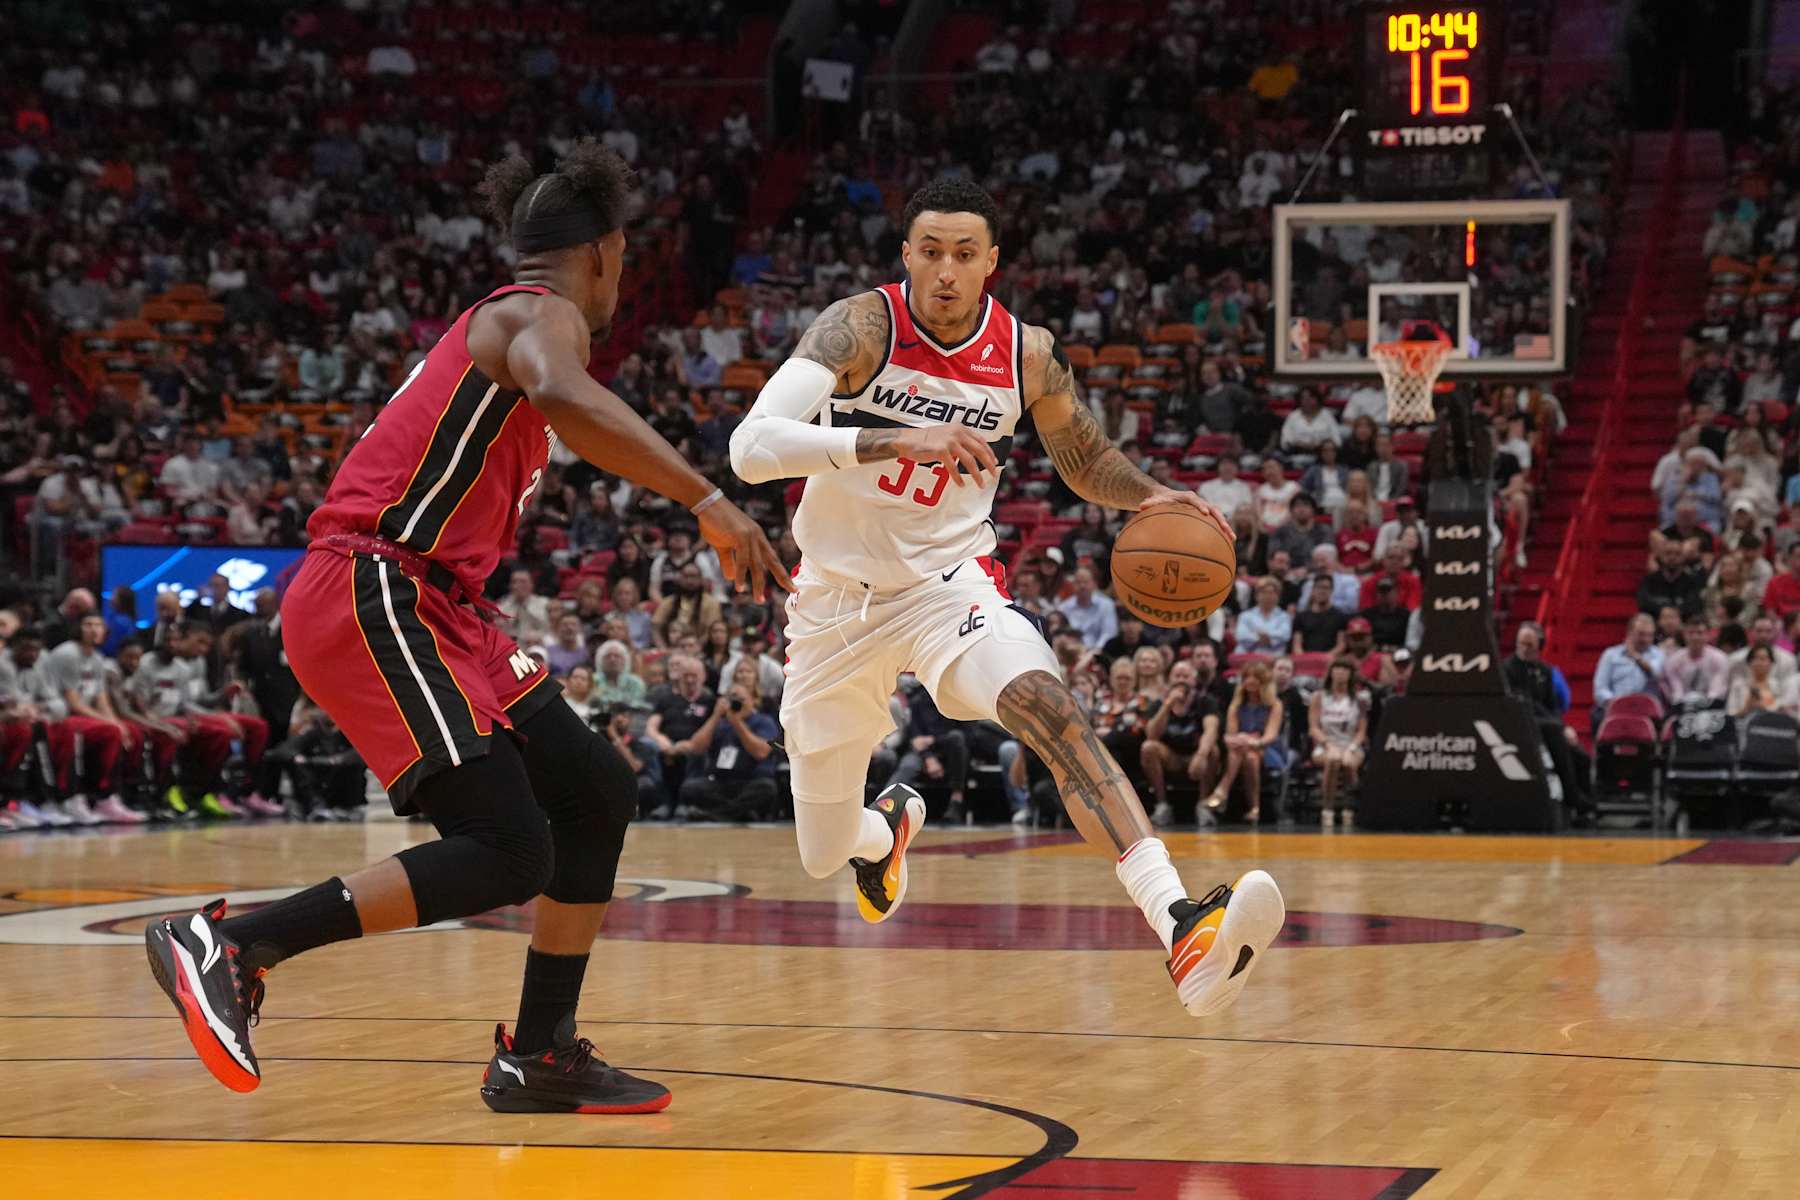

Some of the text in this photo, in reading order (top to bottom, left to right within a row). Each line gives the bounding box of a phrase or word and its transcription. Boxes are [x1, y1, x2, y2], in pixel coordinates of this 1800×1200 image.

[1388, 12, 1478, 52] 10:44
[1410, 49, 1470, 115] 16
[1400, 125, 1485, 146] TISSOT
[970, 363, 1004, 374] Robinhood
[872, 384, 1004, 431] wizards
[1384, 733, 1476, 752] American
[1402, 752, 1476, 771] Airlines
